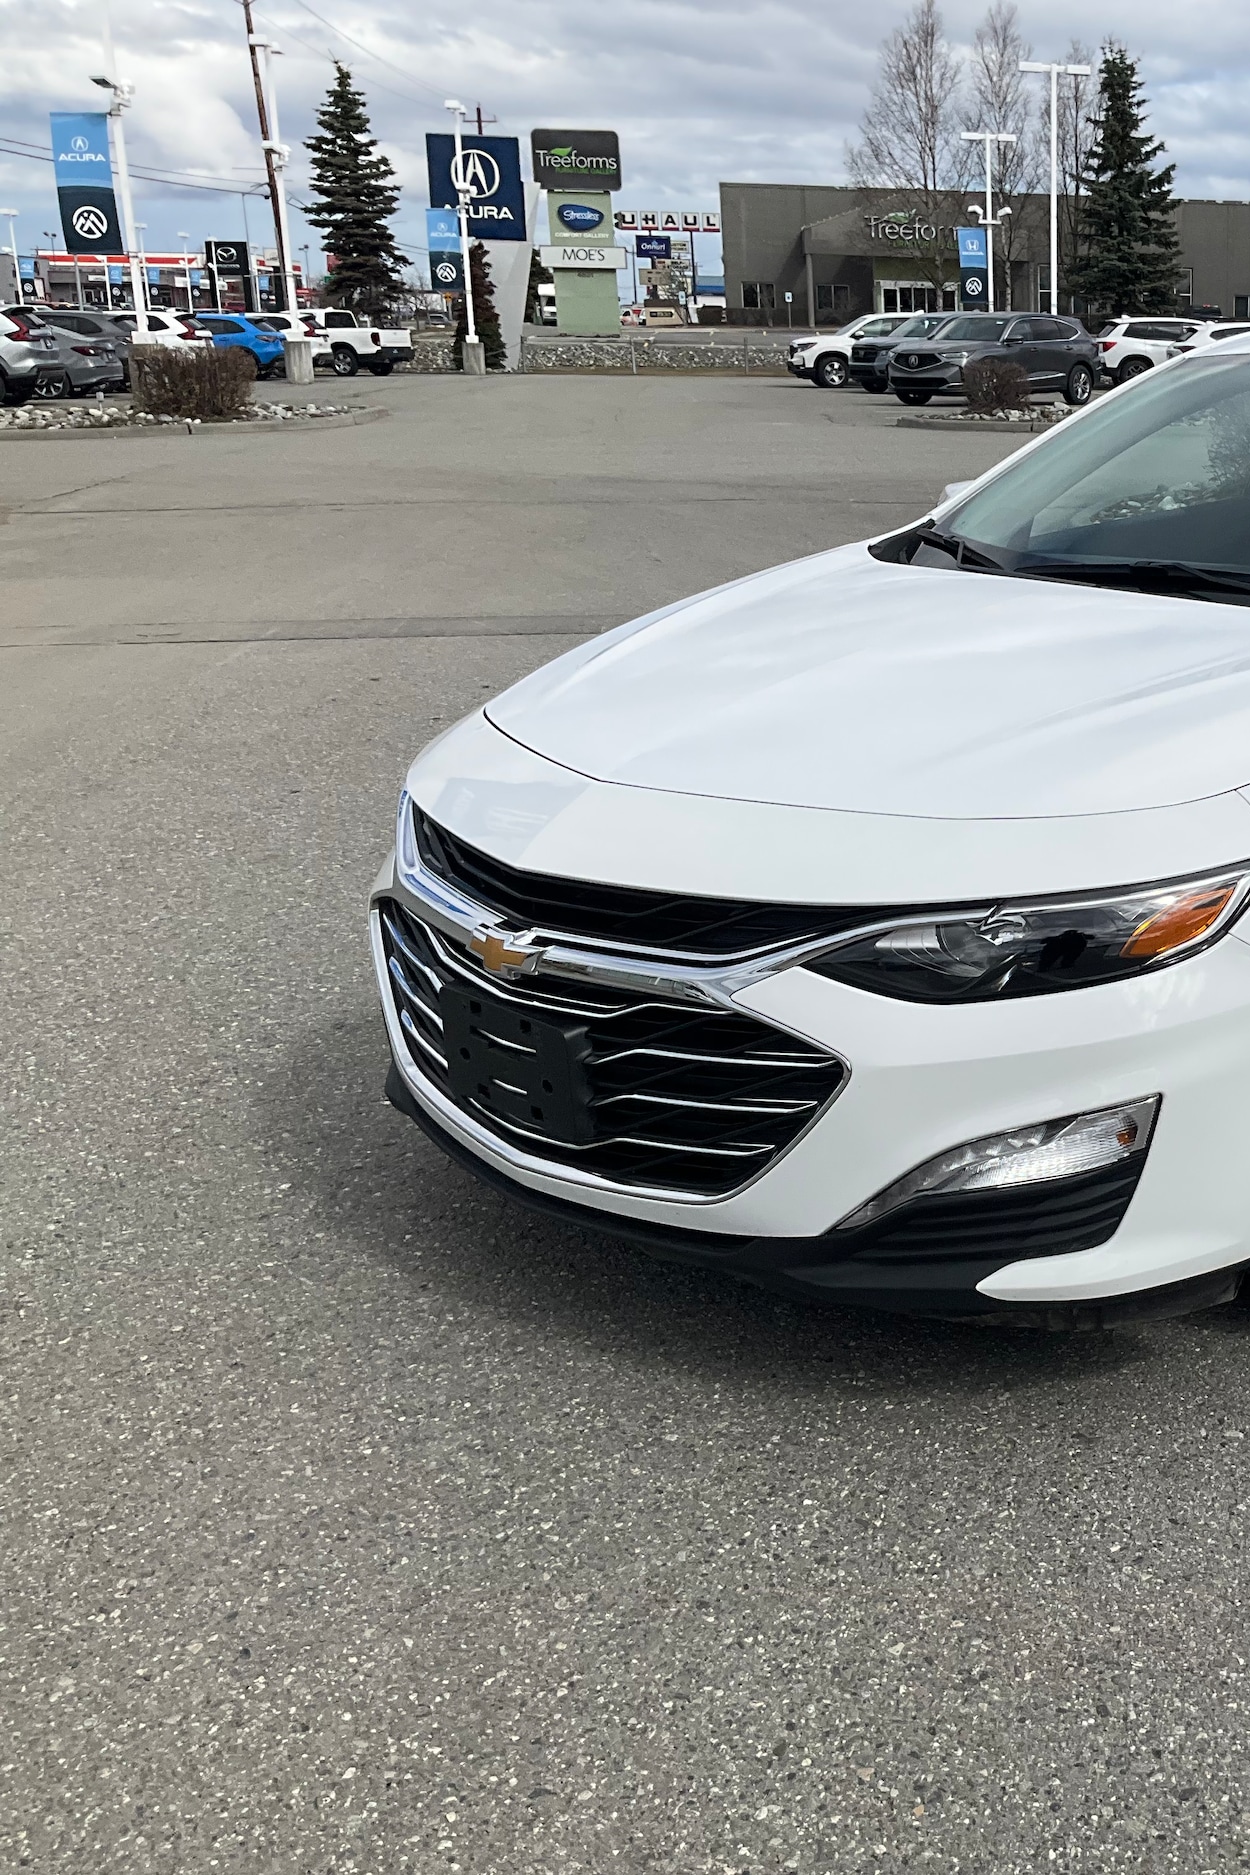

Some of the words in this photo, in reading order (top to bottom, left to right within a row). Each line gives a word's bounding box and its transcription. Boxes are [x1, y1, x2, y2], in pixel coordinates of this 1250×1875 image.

[58, 153, 106, 162] ACURA
[535, 149, 617, 169] Treeforms
[562, 248, 605, 261] MOE'S
